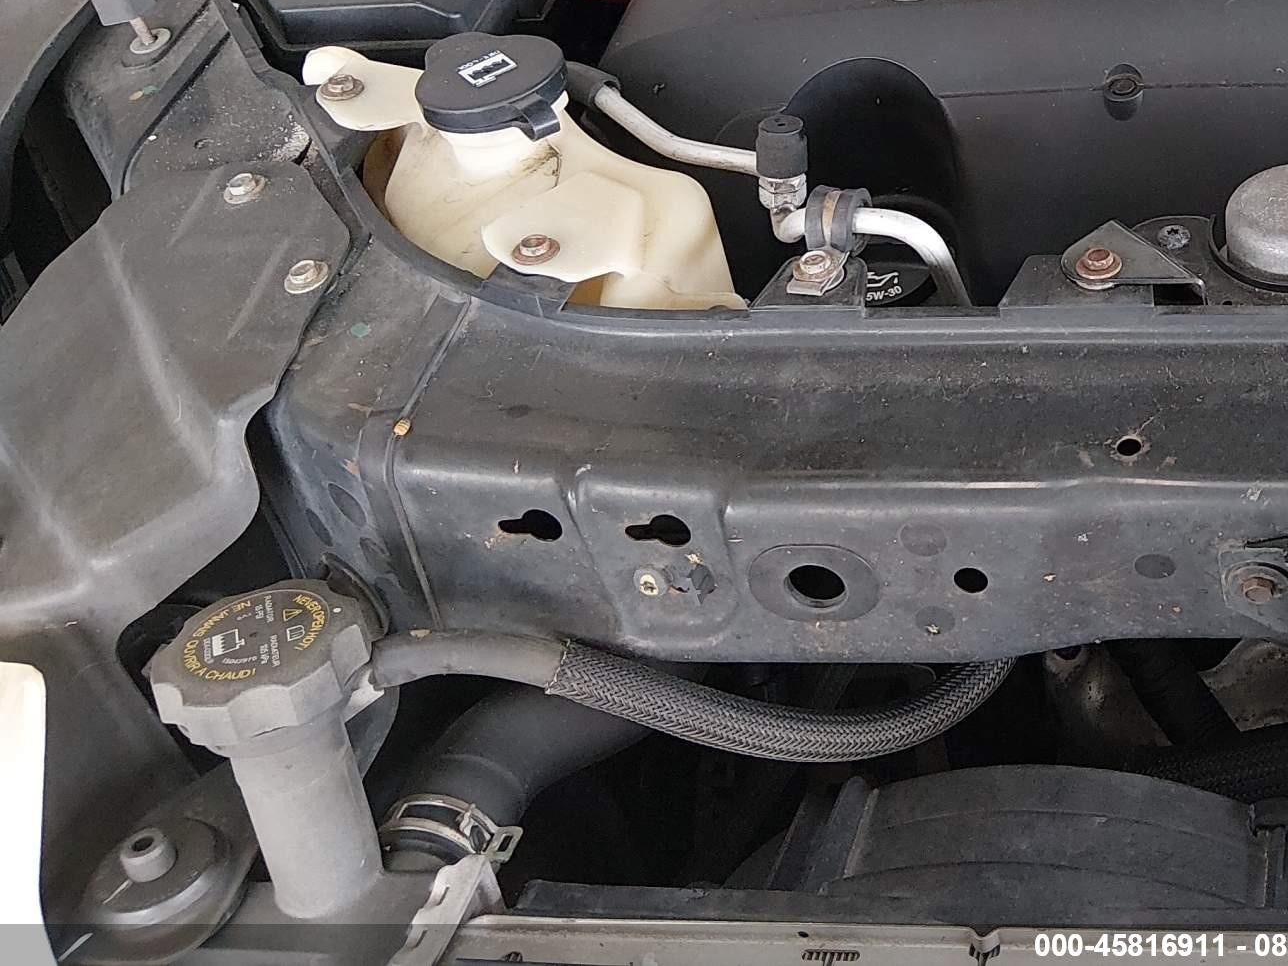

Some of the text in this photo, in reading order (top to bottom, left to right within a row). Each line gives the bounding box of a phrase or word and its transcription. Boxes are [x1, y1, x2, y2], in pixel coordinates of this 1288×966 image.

[865, 285, 902, 301] 5W-30
[232, 600, 251, 613] NE
[264, 595, 275, 623] RADIATOR
[192, 610, 230, 638] JAMAIS
[183, 639, 201, 672] OUVRIR
